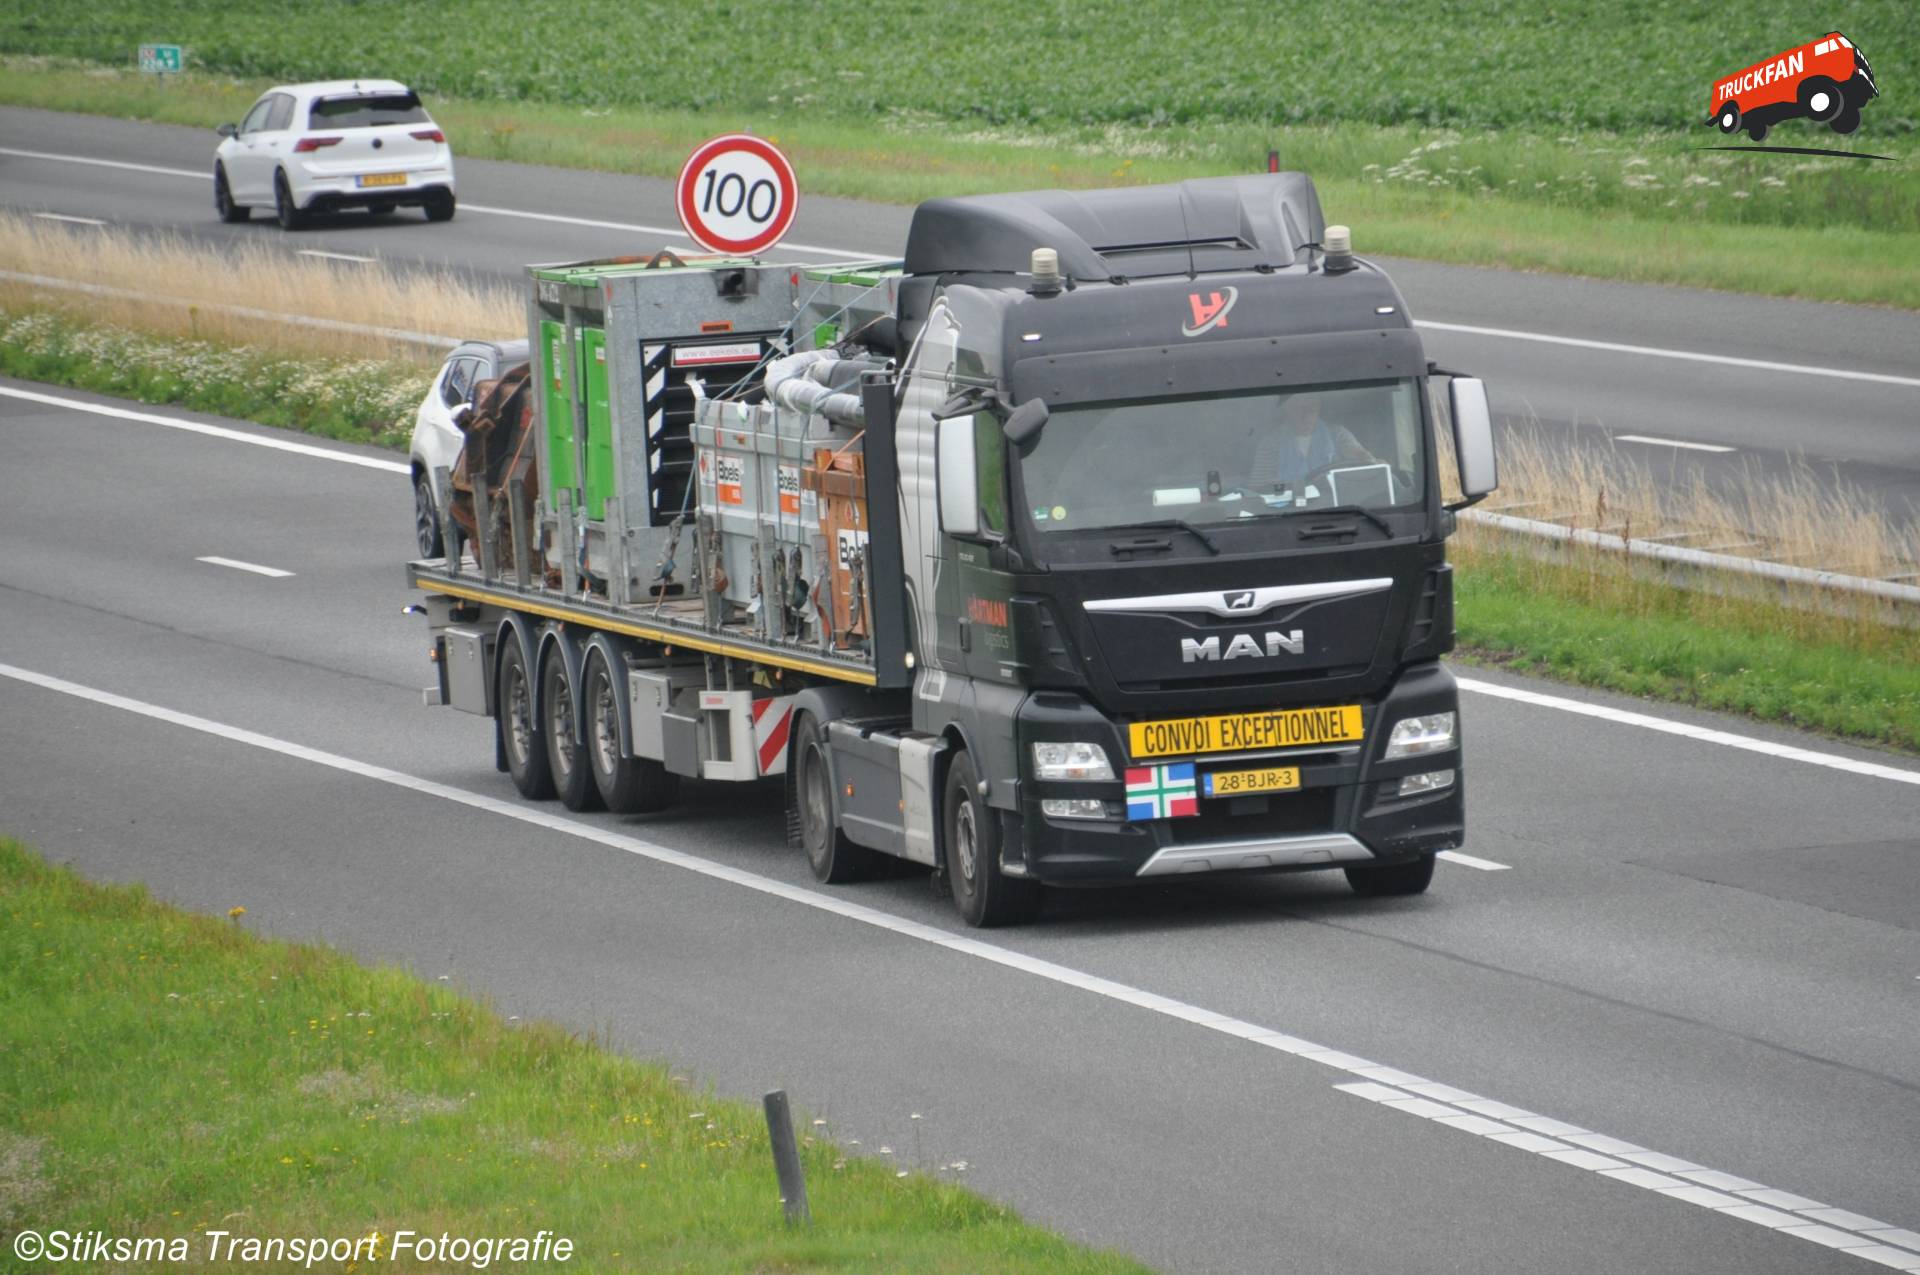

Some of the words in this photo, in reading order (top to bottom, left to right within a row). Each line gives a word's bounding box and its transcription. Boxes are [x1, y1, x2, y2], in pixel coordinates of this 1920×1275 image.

[703, 169, 777, 223] 100
[718, 459, 740, 482] Boels
[1181, 629, 1304, 663] MAN
[1144, 720, 1211, 753] CONVOI
[1220, 710, 1349, 747] EXCEPTIONNEL
[1219, 771, 1292, 791] 28-BJR-3
